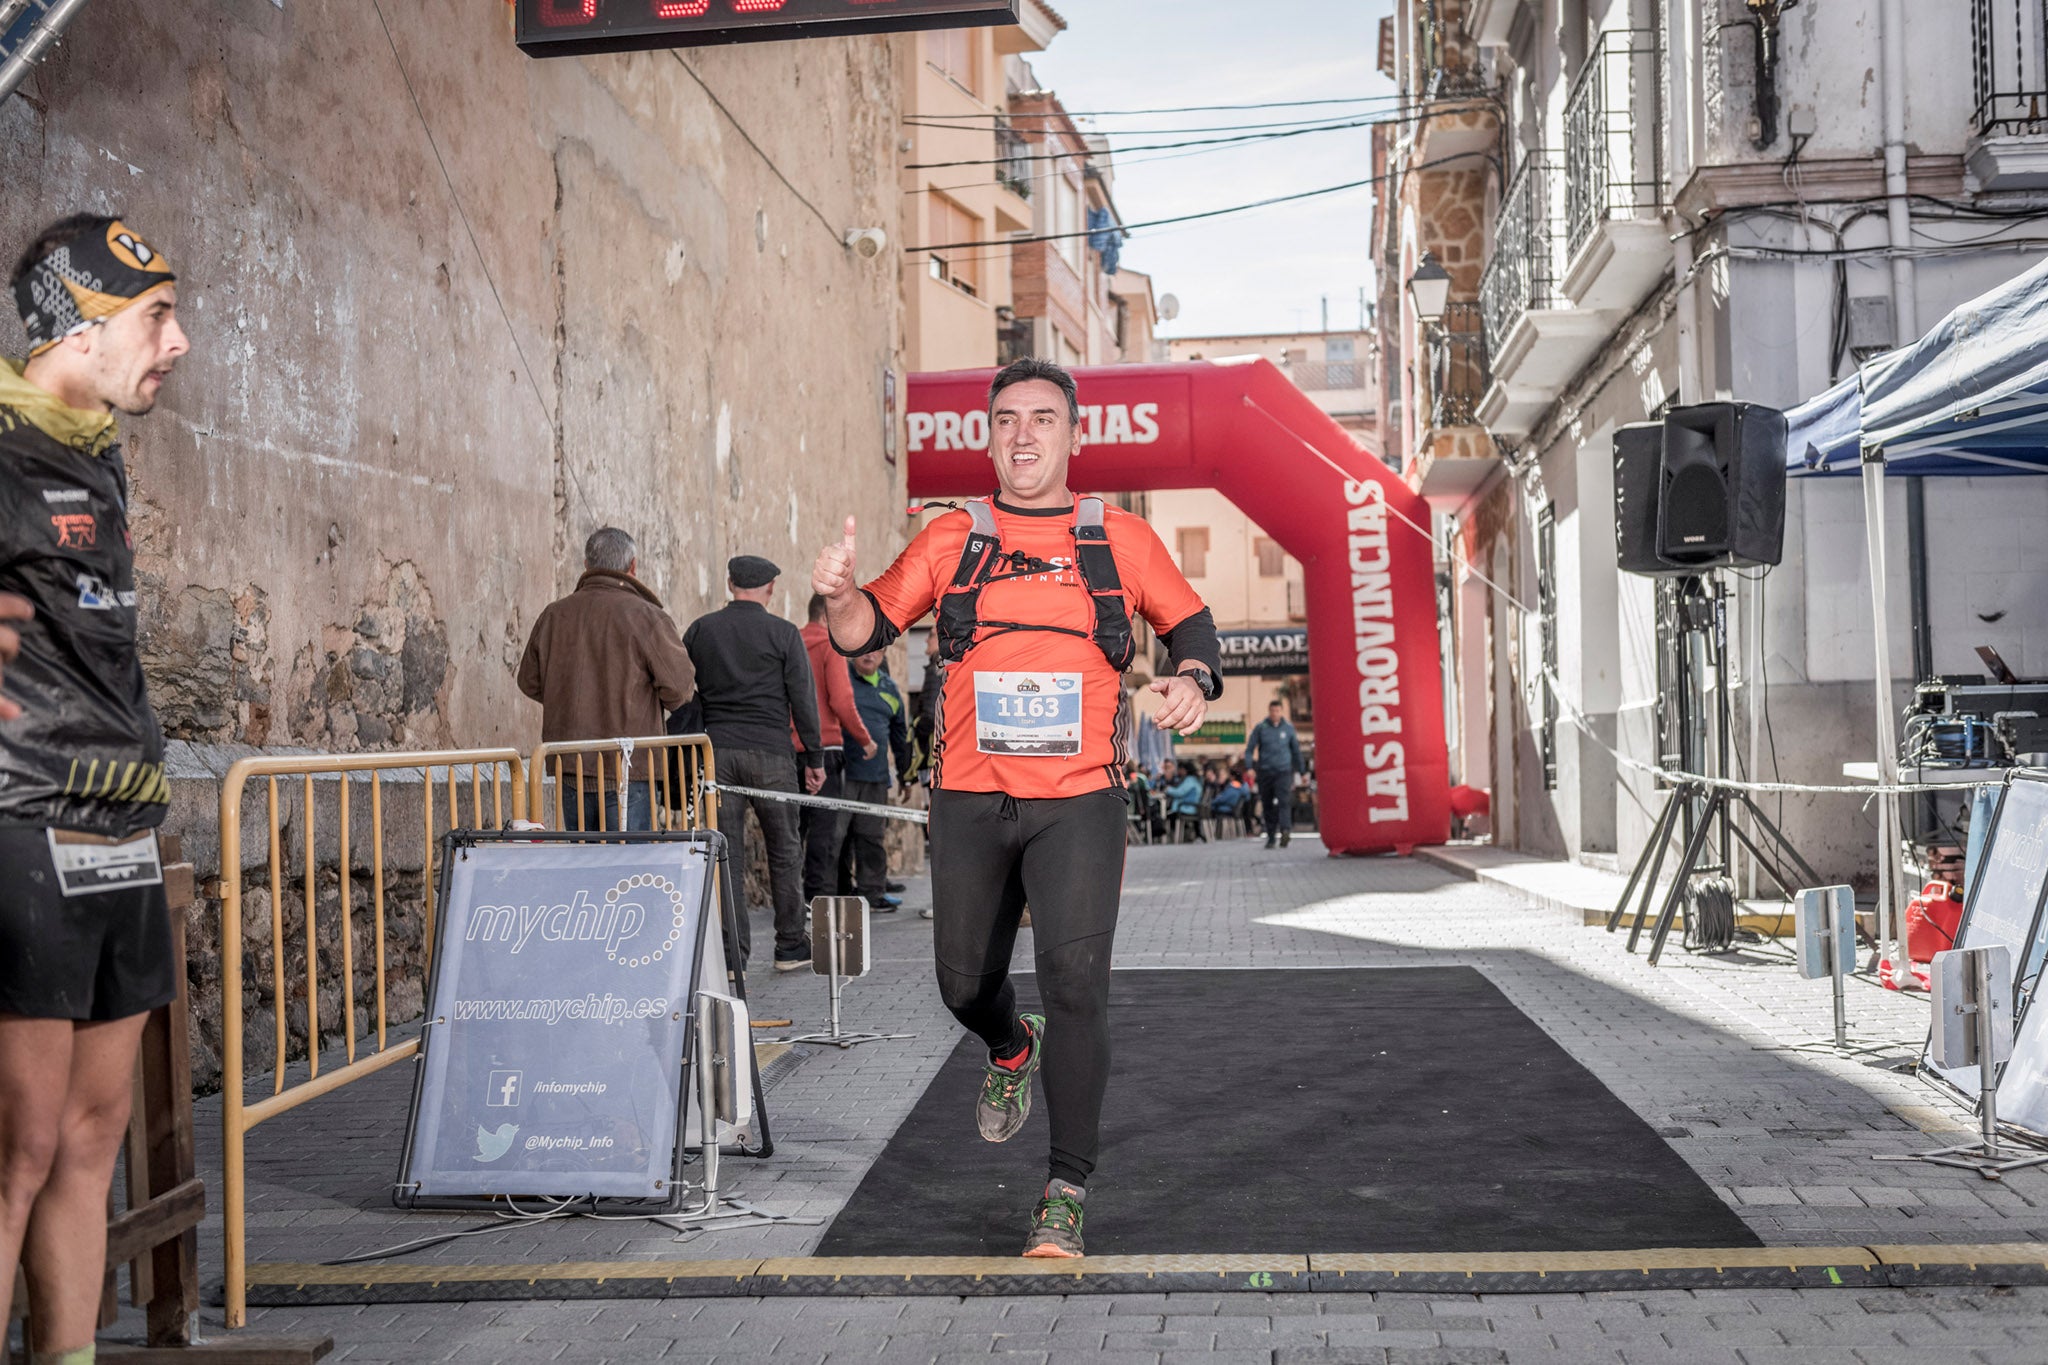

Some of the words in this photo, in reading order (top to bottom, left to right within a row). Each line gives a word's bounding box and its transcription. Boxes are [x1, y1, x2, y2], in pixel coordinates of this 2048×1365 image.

[906, 402, 1160, 451] PROCIAS
[1343, 478, 1402, 736] PROVINCIAS
[998, 697, 1060, 718] 1163
[1366, 738, 1409, 824] LAS
[466, 890, 645, 953] mychip
[454, 993, 667, 1025] www.mychip.es
[533, 1081, 607, 1096] /infomychip
[525, 1136, 614, 1150] @Mychip_Info
